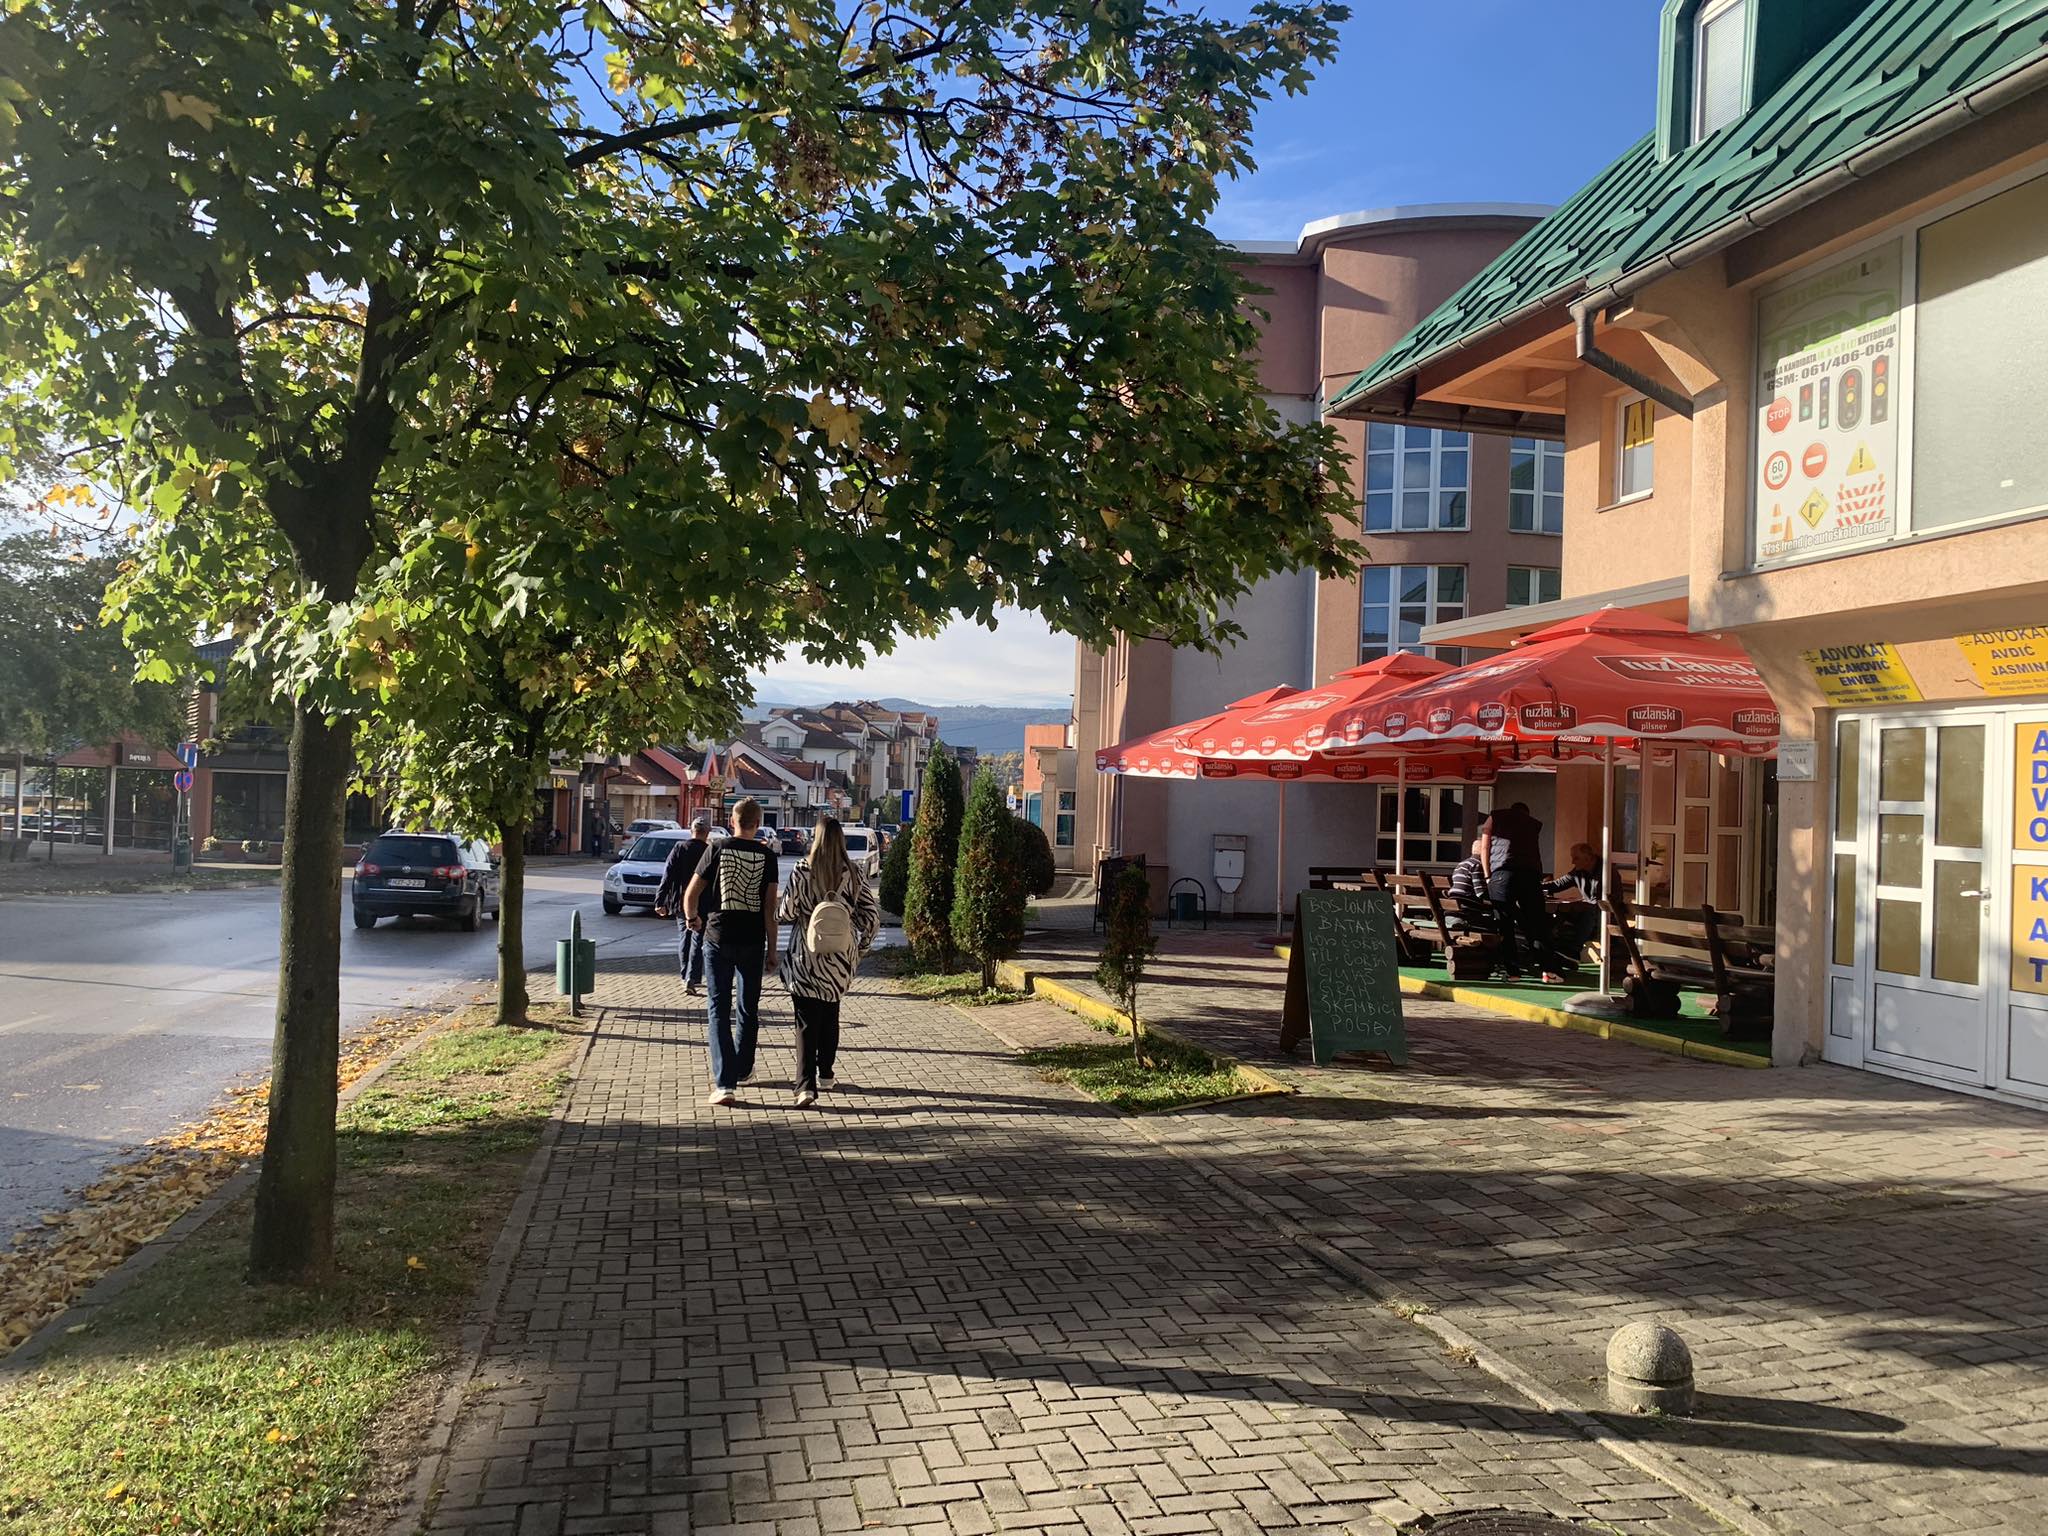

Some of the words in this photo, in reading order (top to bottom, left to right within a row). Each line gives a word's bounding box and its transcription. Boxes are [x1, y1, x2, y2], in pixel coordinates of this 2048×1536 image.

[1766, 373, 1799, 391] GSM:
[1801, 337, 1895, 379] 061/406-064
[1768, 406, 1790, 422] STOP
[1772, 460, 1784, 474] 60
[1819, 642, 1889, 662] ADVOKAT
[1838, 674, 1881, 687] ENVER
[1632, 704, 1677, 721] tuzlanski
[1737, 708, 1781, 725] tuzlanski
[1534, 720, 1563, 730] pilsner
[1641, 722, 1669, 732] pilsner
[1745, 726, 1773, 735] pilsner
[1318, 914, 1377, 933] BATAK
